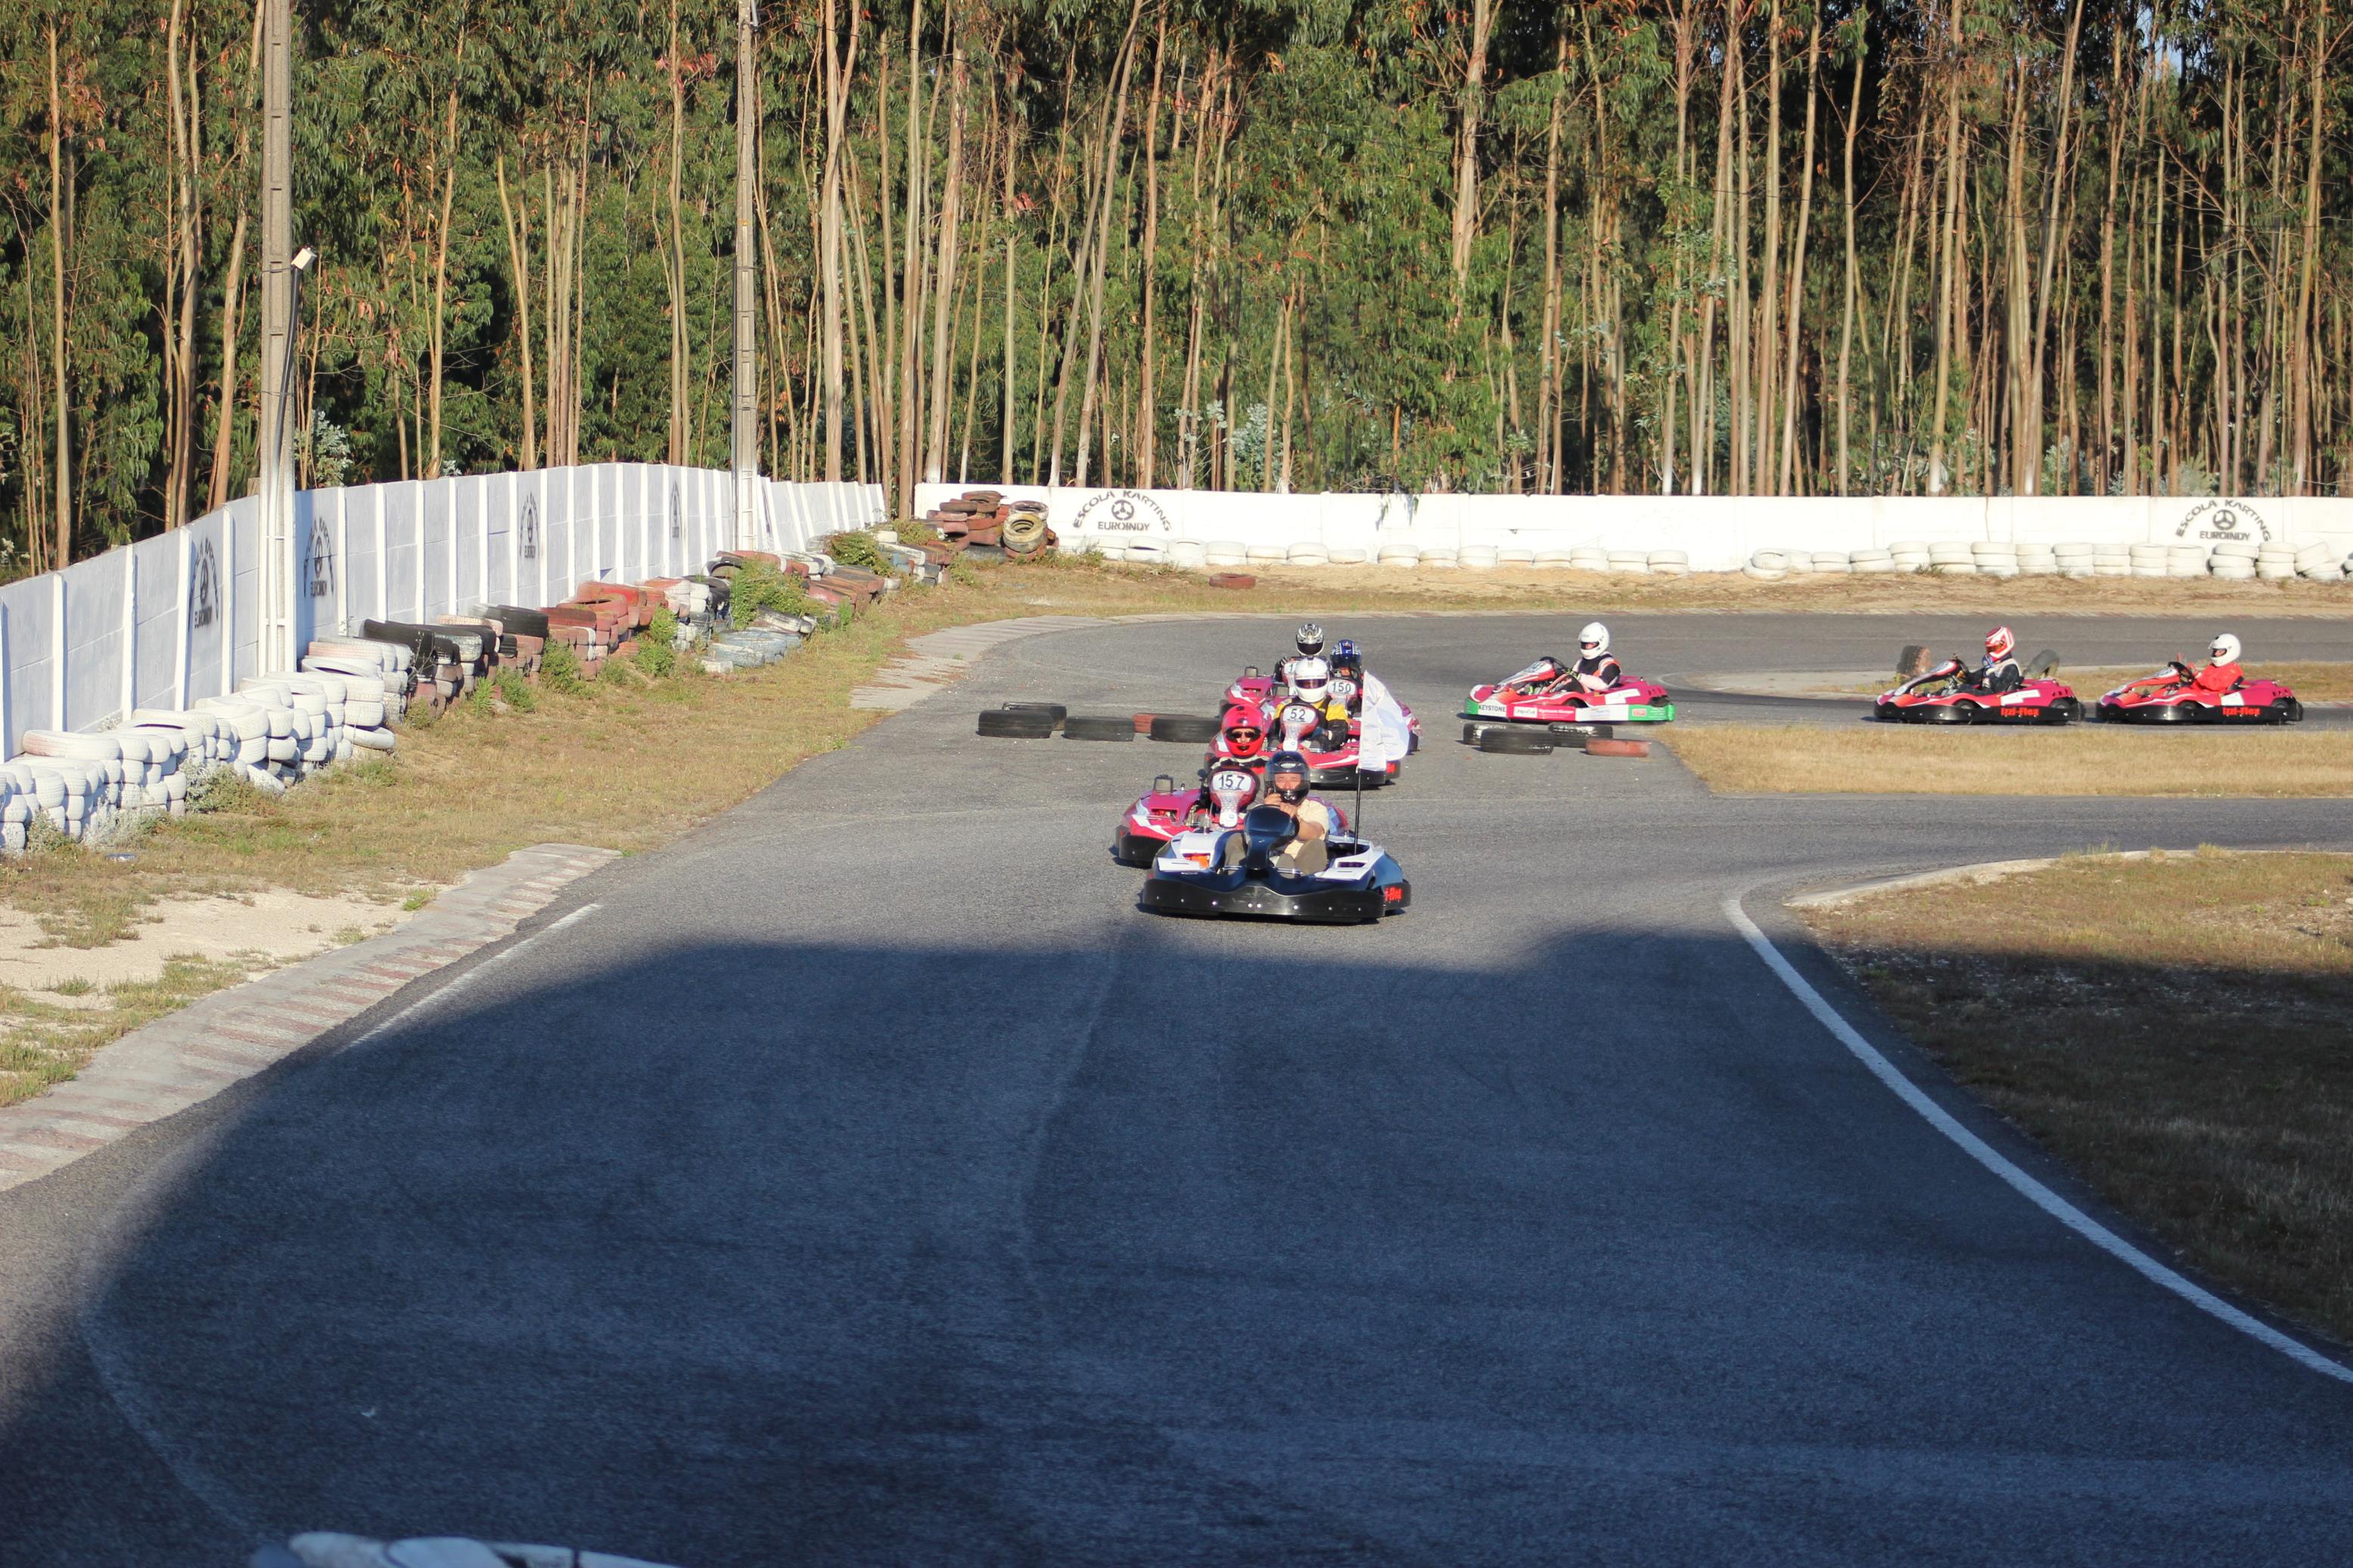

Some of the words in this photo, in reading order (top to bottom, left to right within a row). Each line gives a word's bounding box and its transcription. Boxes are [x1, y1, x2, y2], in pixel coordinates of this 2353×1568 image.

[1073, 490, 1115, 529] ESCOLA
[1123, 490, 1172, 532] KARTING
[1098, 520, 1151, 531] EUROINDY
[2175, 499, 2218, 538] ESCOLA
[2224, 499, 2272, 542] KARTING
[2199, 530, 2250, 541] EUROINDY
[1332, 682, 1352, 693] 150
[1290, 708, 1306, 721] 52
[1218, 774, 1245, 788] 157
